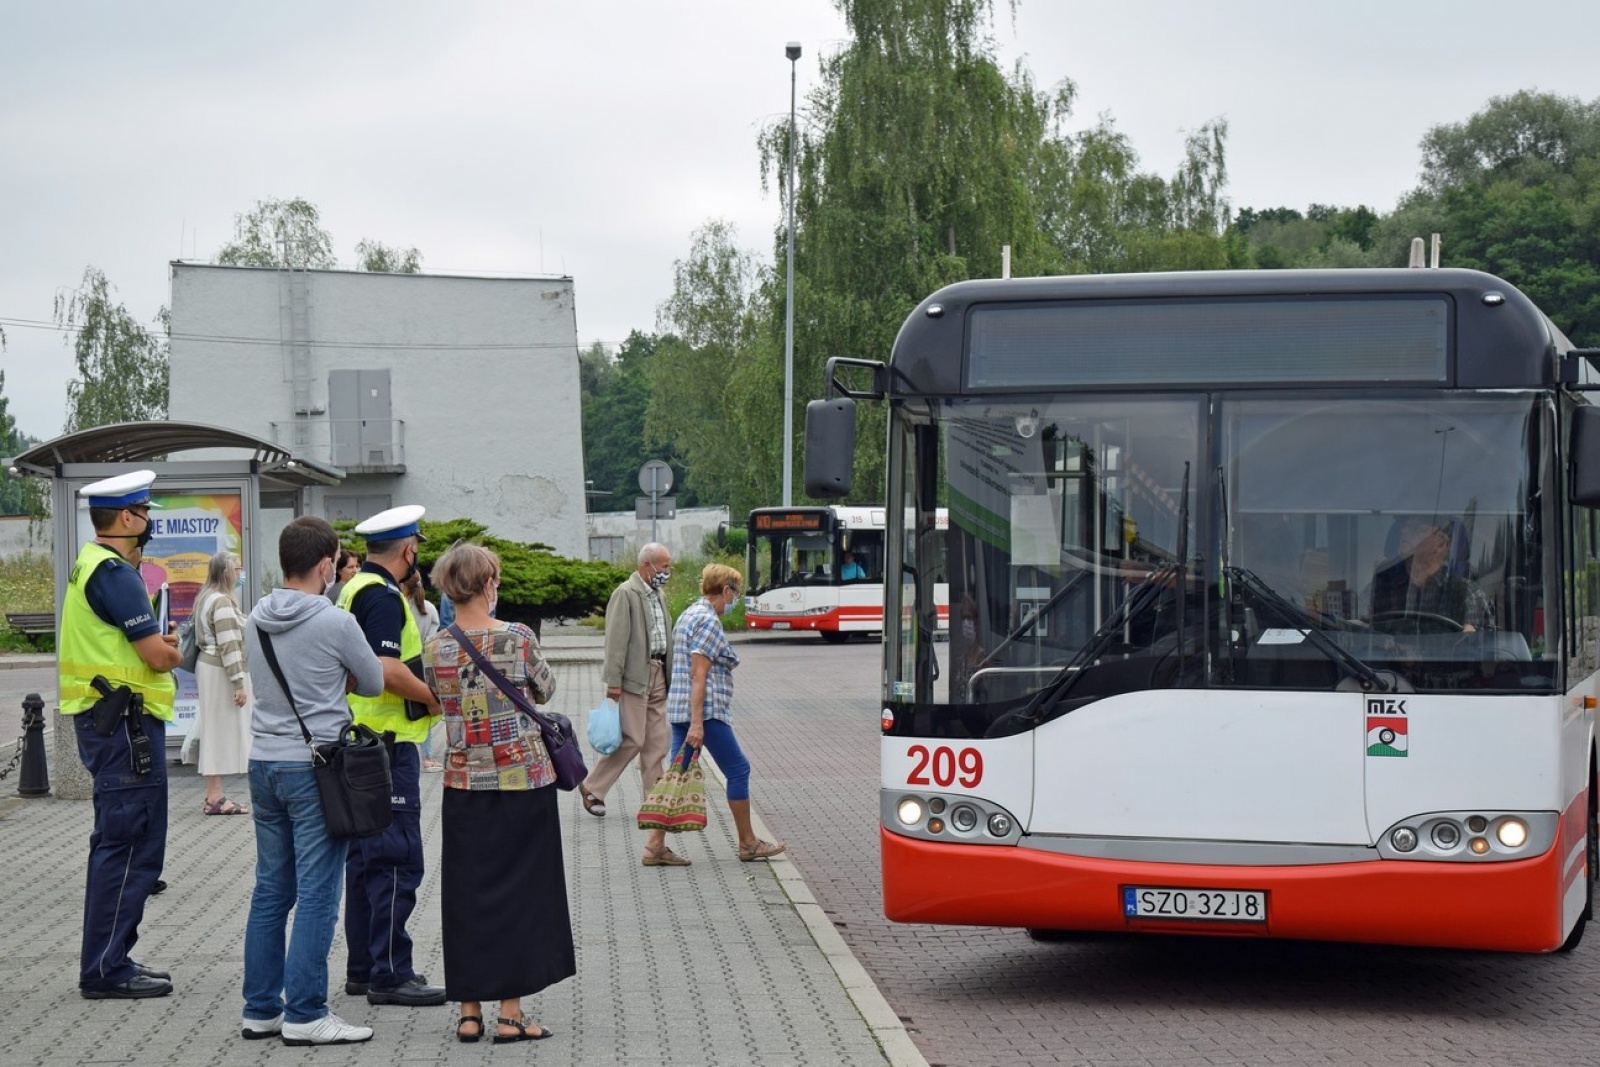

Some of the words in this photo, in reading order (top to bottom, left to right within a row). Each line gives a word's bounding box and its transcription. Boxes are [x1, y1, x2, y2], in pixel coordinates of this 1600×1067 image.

[166, 517, 219, 534] MIASTO?
[124, 613, 152, 628] POLICJA
[1367, 699, 1407, 714] MZK
[906, 744, 984, 789] 209
[1197, 893, 1259, 916] 32J8
